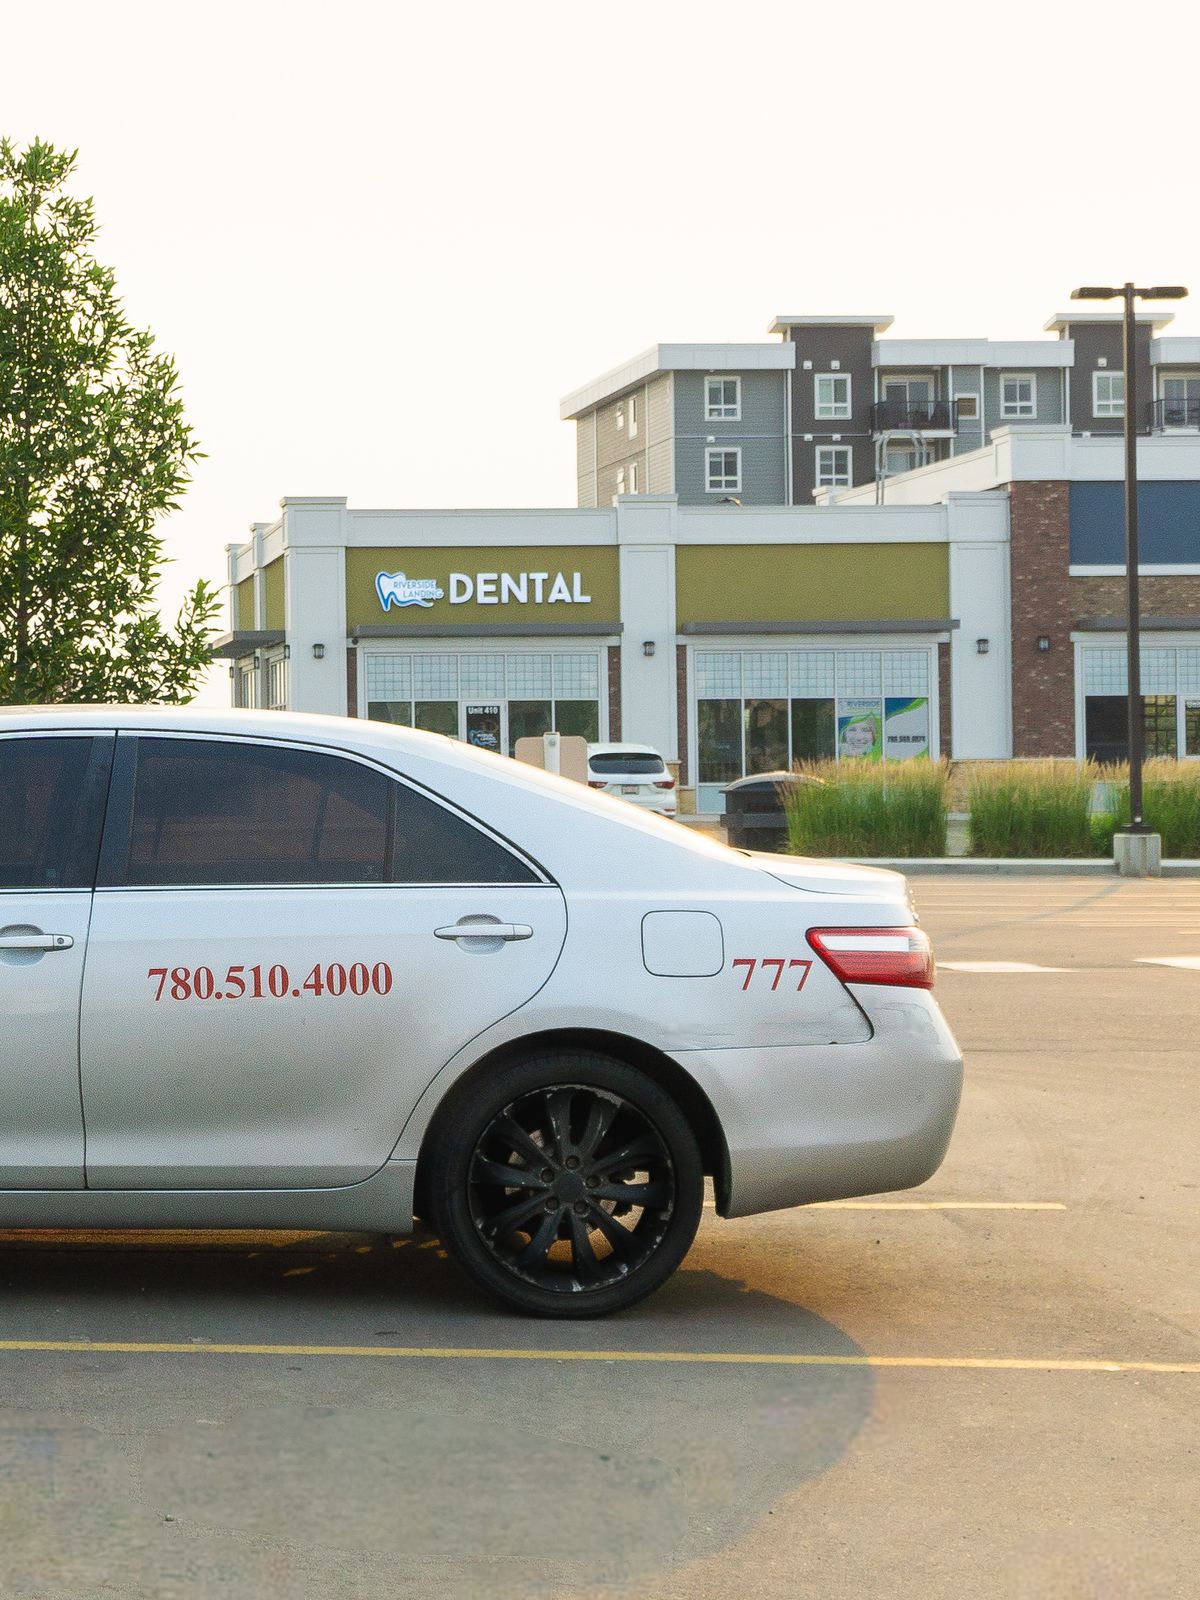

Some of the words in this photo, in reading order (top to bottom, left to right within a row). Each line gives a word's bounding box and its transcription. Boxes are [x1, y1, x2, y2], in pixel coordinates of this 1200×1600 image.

[393, 581, 435, 589] RIVERSIDE
[403, 590, 443, 598] LANDING
[449, 572, 592, 604] DENTAL
[147, 961, 393, 1002] 780.510.4000
[732, 958, 814, 992] 777
